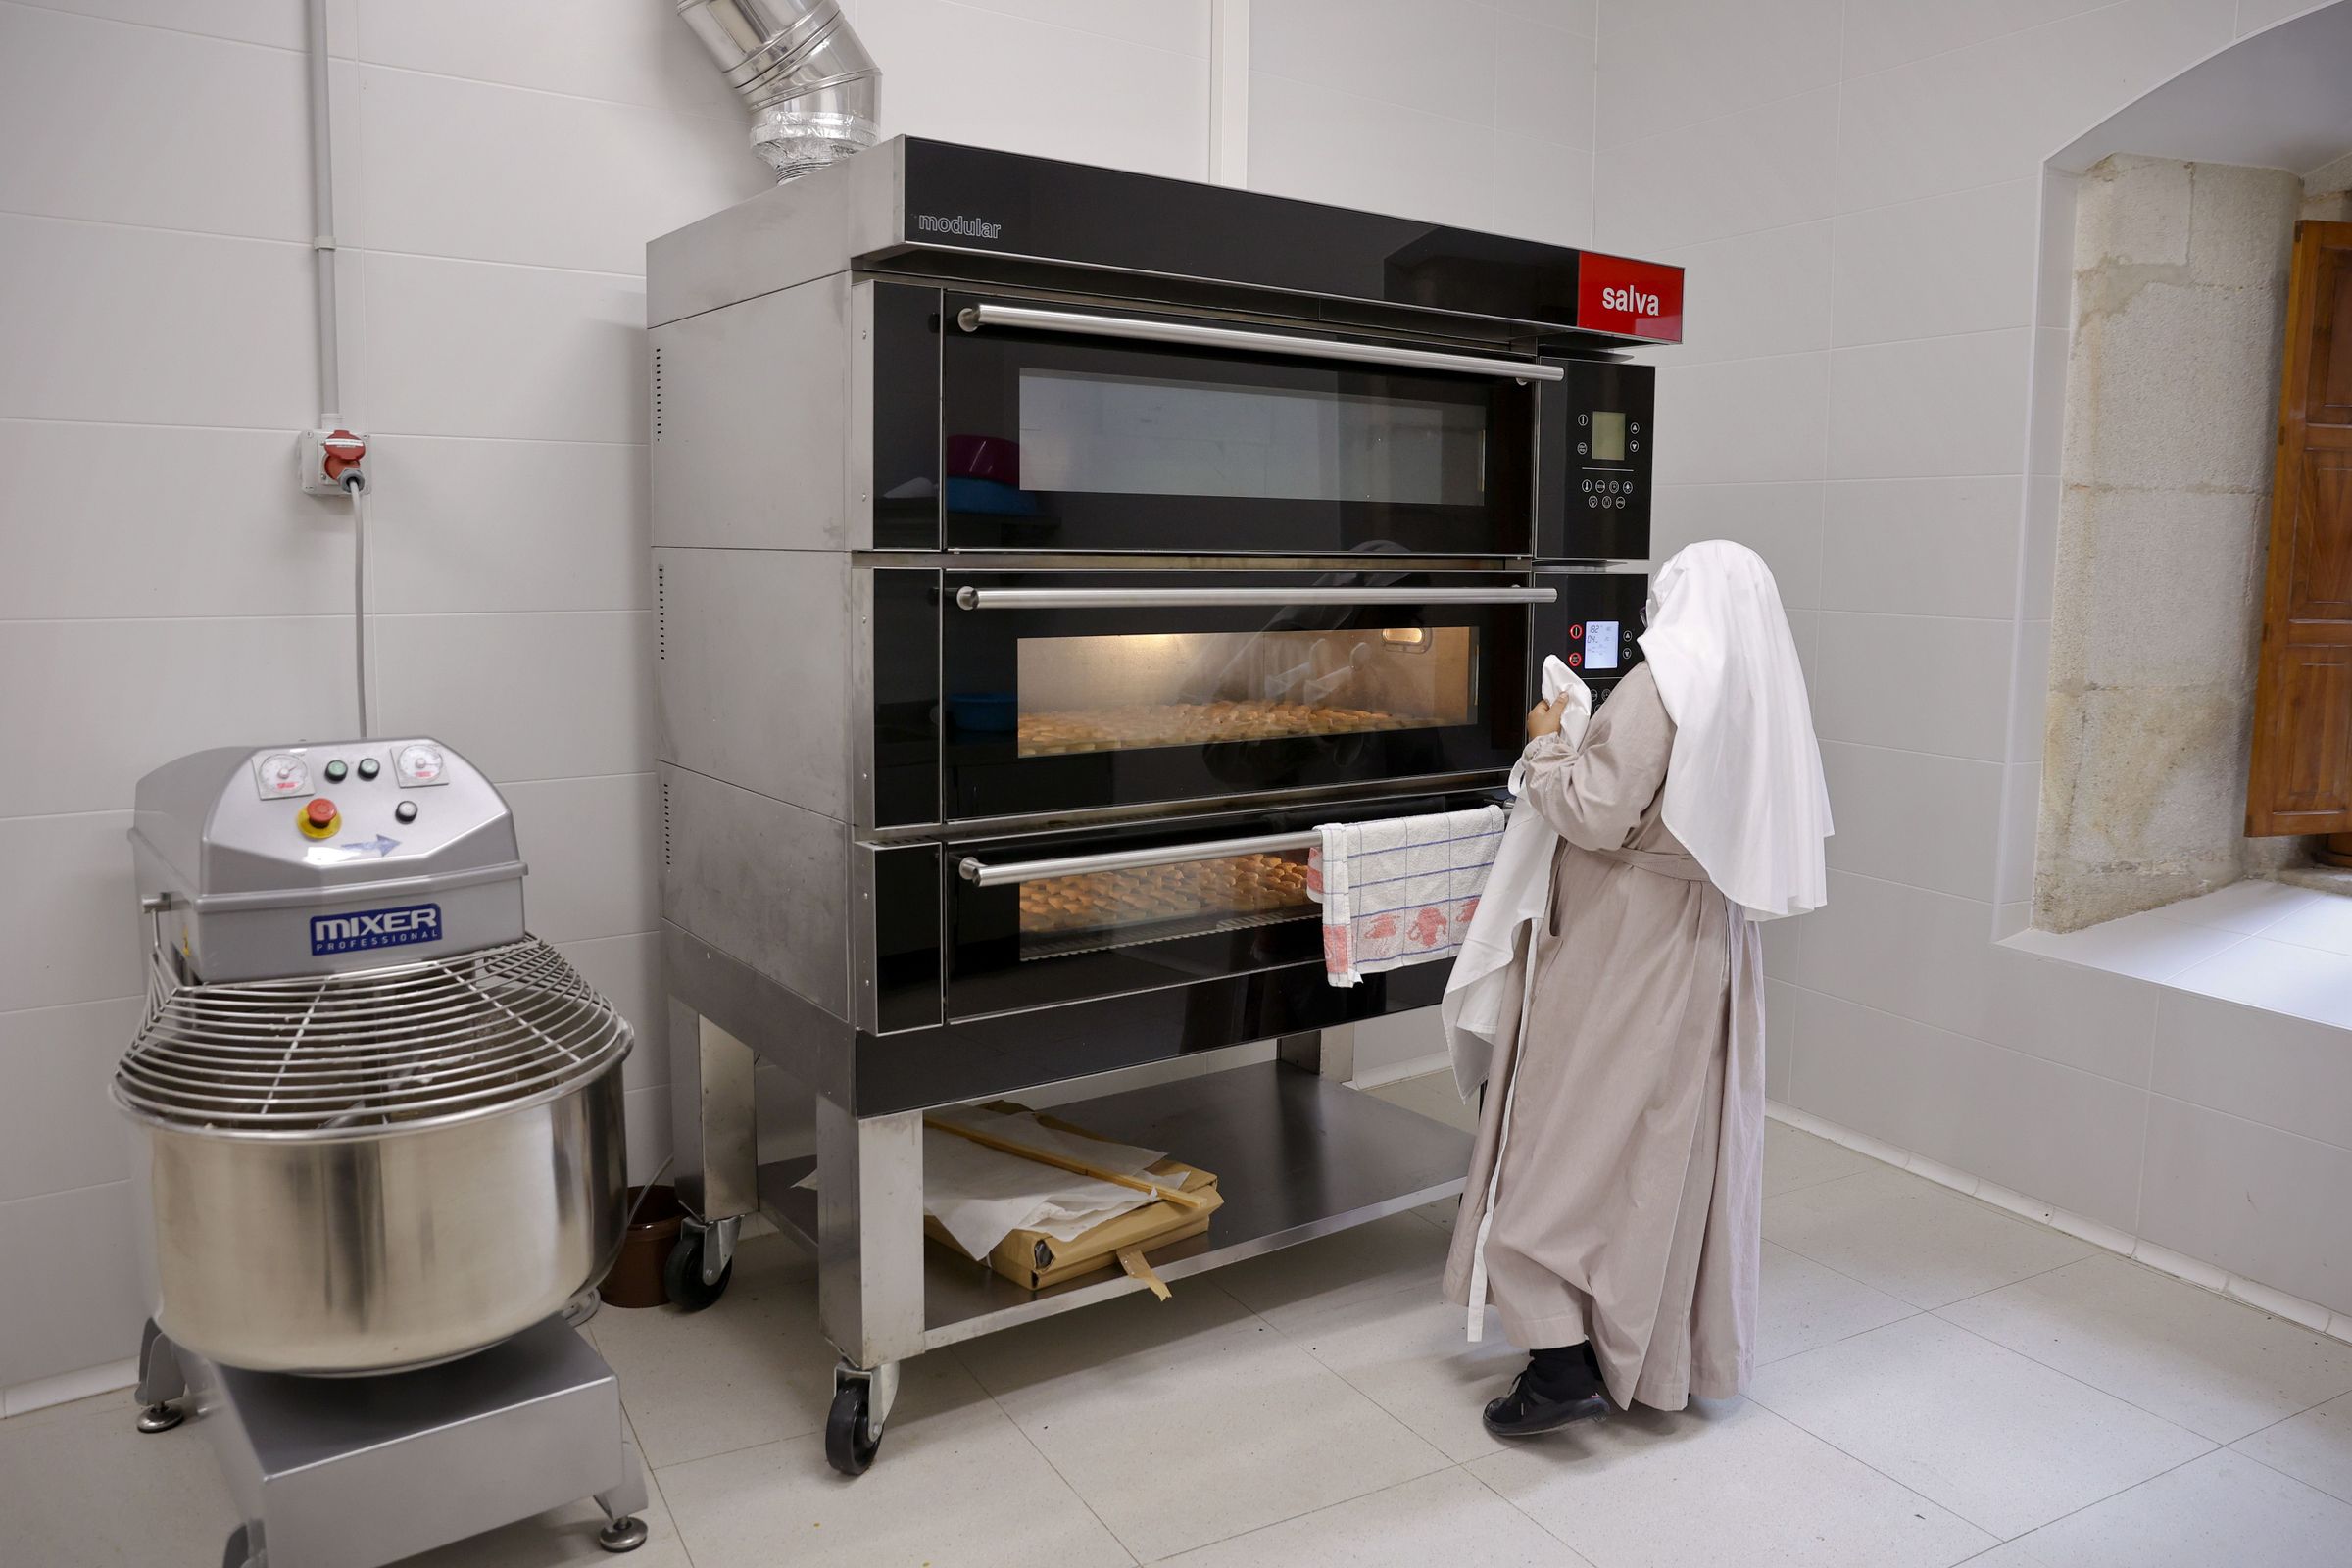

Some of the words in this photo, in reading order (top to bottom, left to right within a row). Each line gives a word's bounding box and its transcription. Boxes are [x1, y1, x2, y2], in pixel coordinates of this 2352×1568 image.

[919, 215, 1002, 239] modular
[1602, 284, 1660, 316] salva
[315, 907, 437, 941] MIXER
[317, 930, 438, 952] PROFESSIONAL
